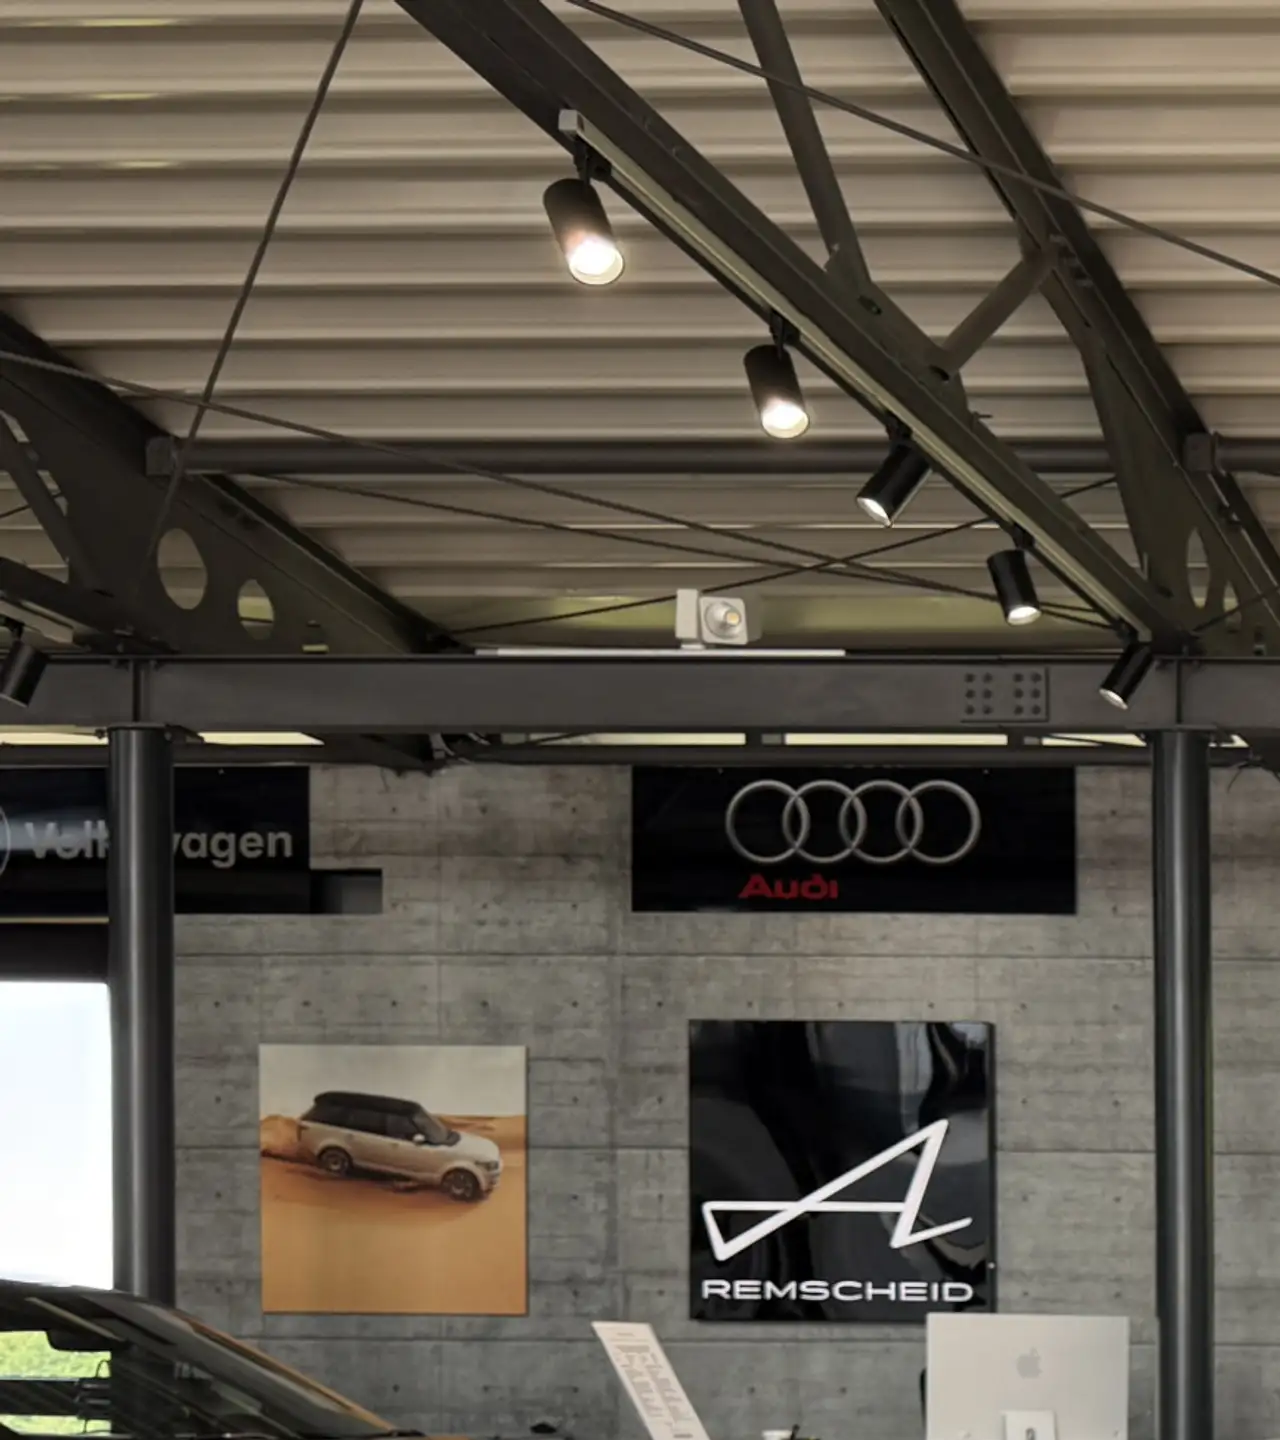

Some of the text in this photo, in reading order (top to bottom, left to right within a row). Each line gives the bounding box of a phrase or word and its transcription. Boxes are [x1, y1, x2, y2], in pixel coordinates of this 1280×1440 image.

[25, 819, 293, 868] Volkagen
[737, 873, 839, 899] Audi
[702, 1279, 974, 1302] REMSCHEID
